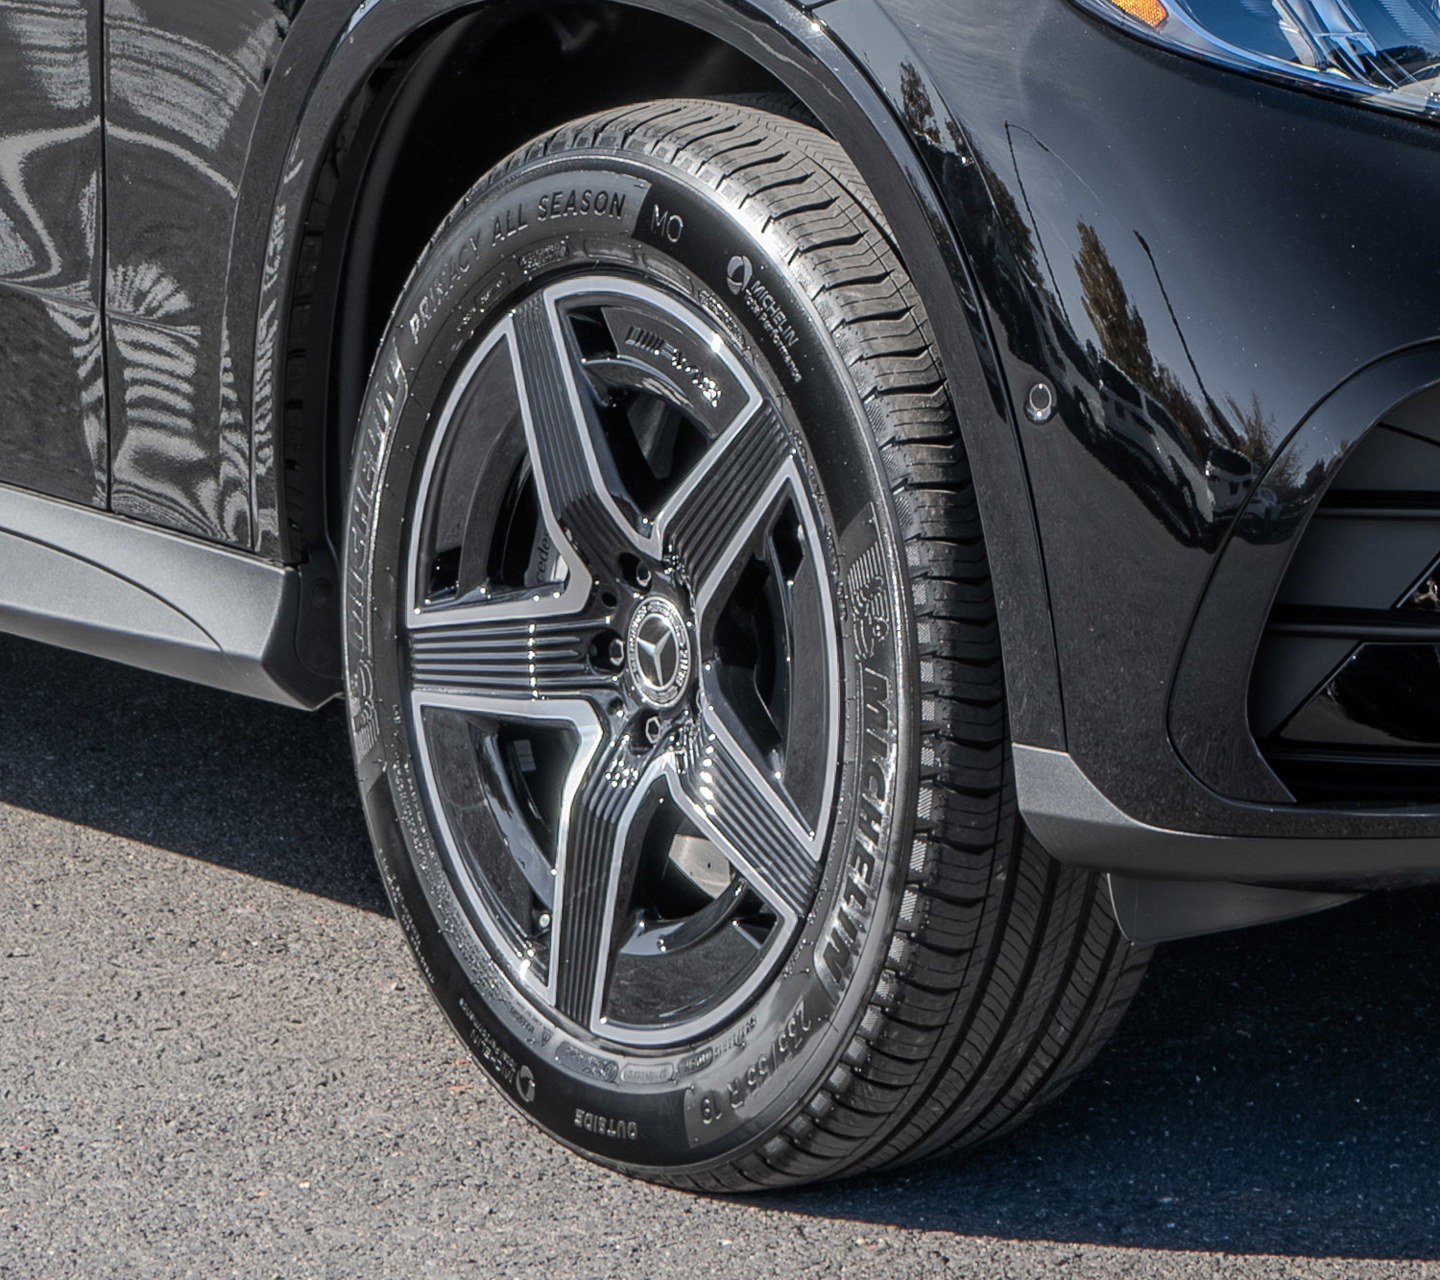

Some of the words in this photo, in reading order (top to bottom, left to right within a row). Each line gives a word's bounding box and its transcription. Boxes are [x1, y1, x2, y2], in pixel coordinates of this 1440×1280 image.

[491, 202, 529, 247] ALL
[537, 189, 627, 222] SEASON
[650, 203, 684, 243] MO
[750, 280, 800, 348] MICHELIN
[759, 312, 802, 383] Performance
[824, 666, 897, 986] MICHELIN
[573, 1108, 639, 1140] OUTSIDE
